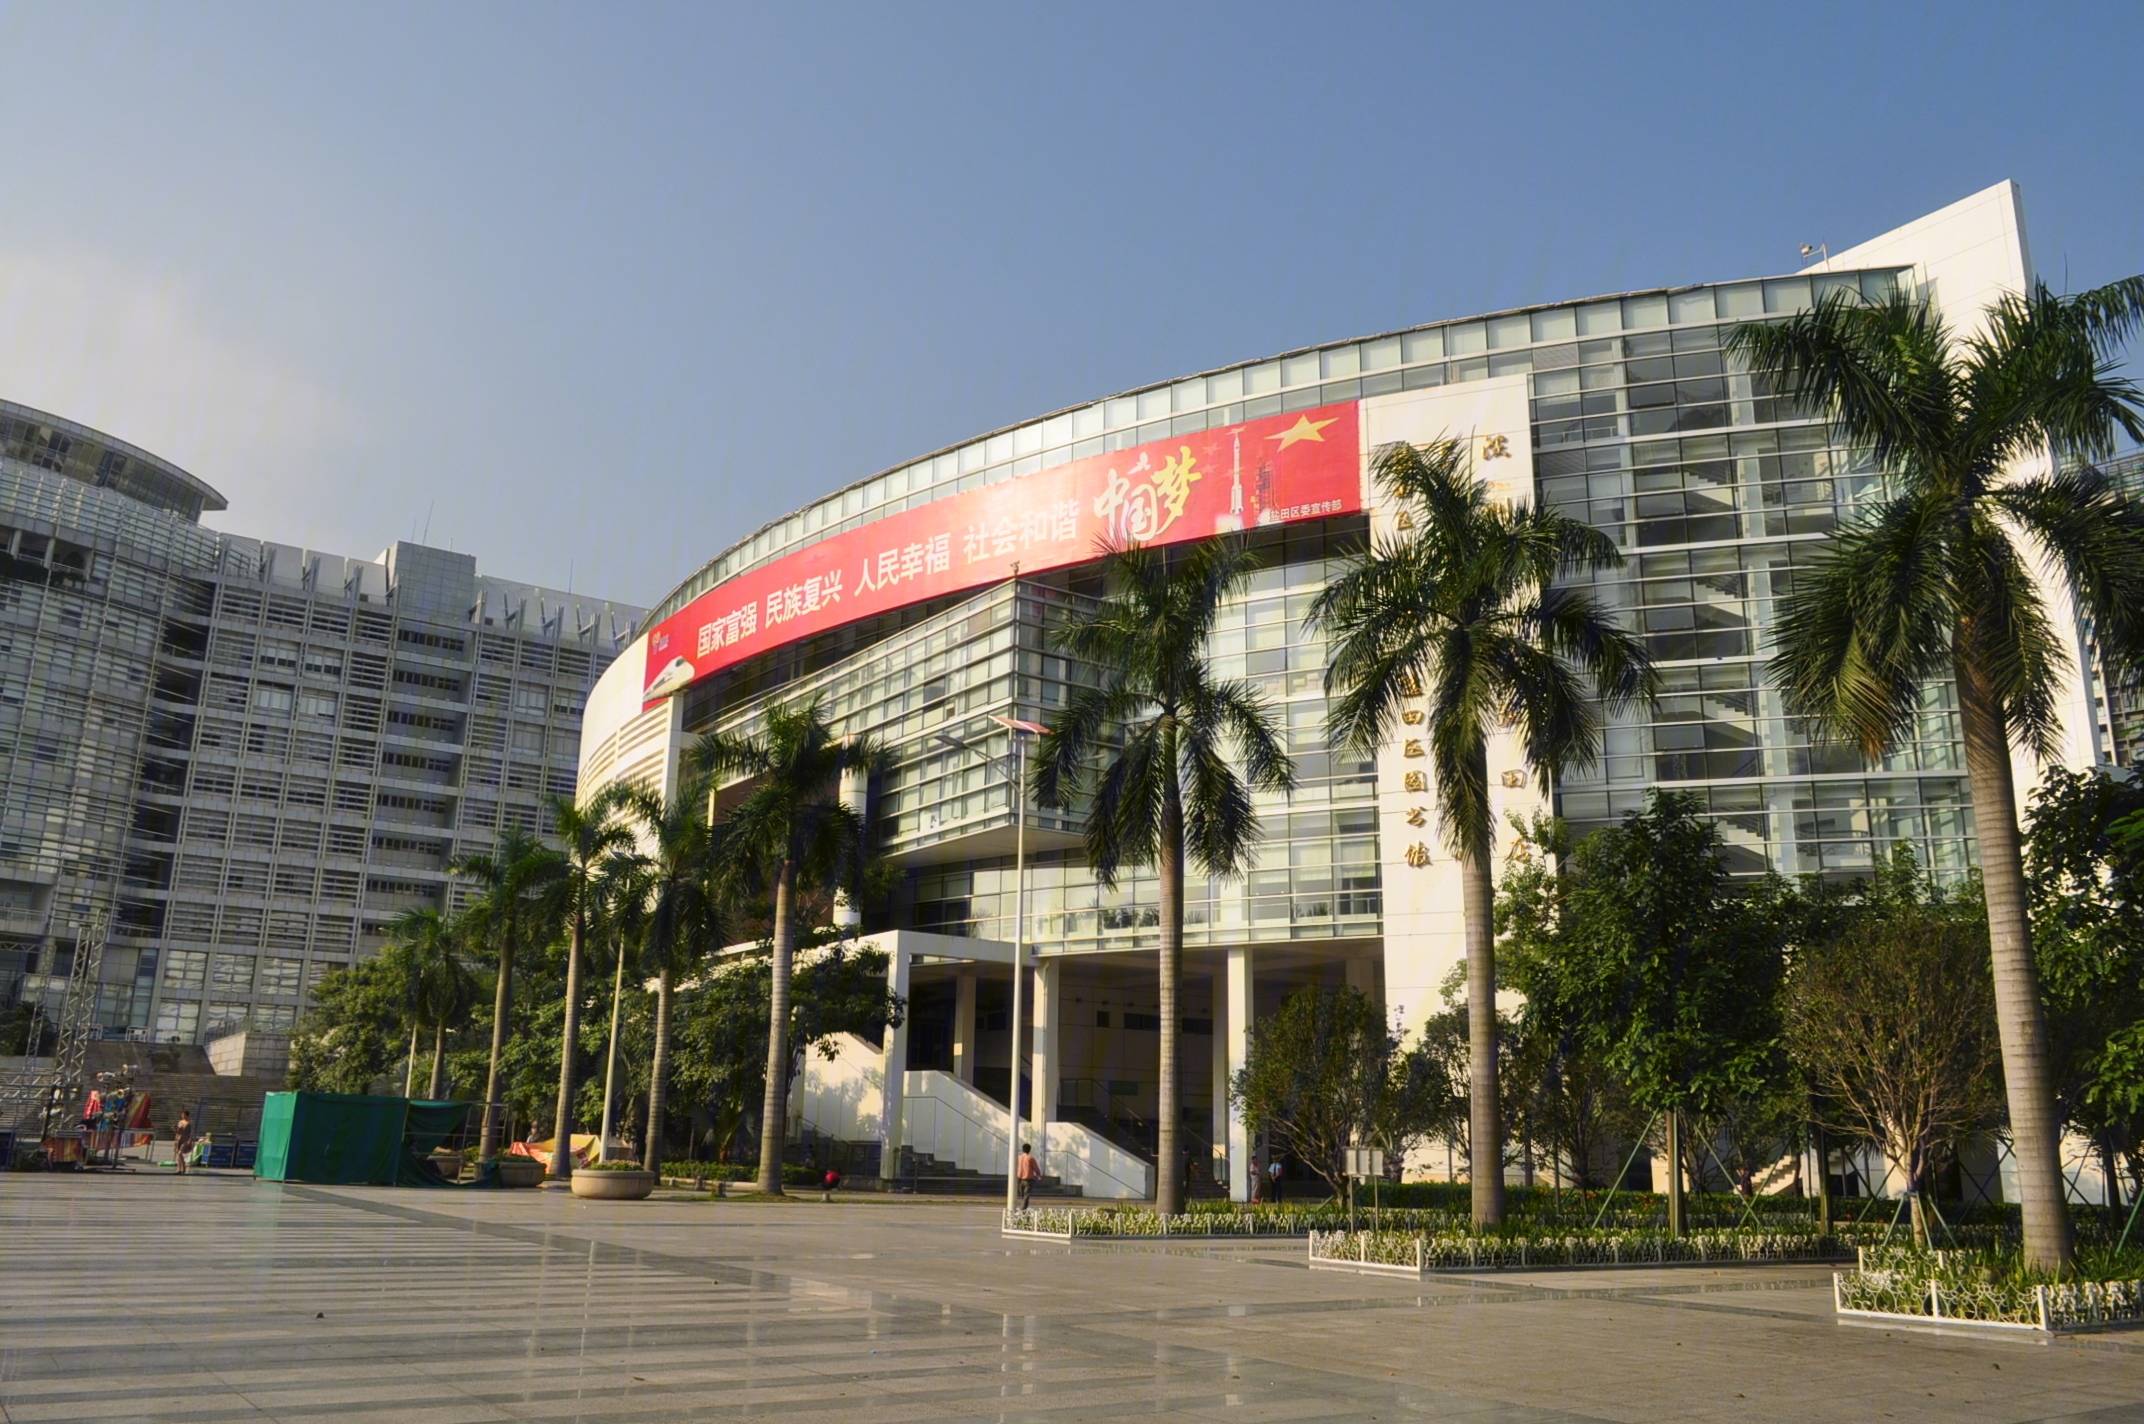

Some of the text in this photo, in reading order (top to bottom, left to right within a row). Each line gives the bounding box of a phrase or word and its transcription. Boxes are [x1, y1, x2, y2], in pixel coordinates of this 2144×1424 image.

[1093, 446, 1204, 542] 中国梦
[696, 601, 758, 659] 国家富强
[765, 569, 843, 629] 民族复兴
[854, 532, 952, 598] 人民幸福
[964, 500, 1079, 564] 社会和谐
